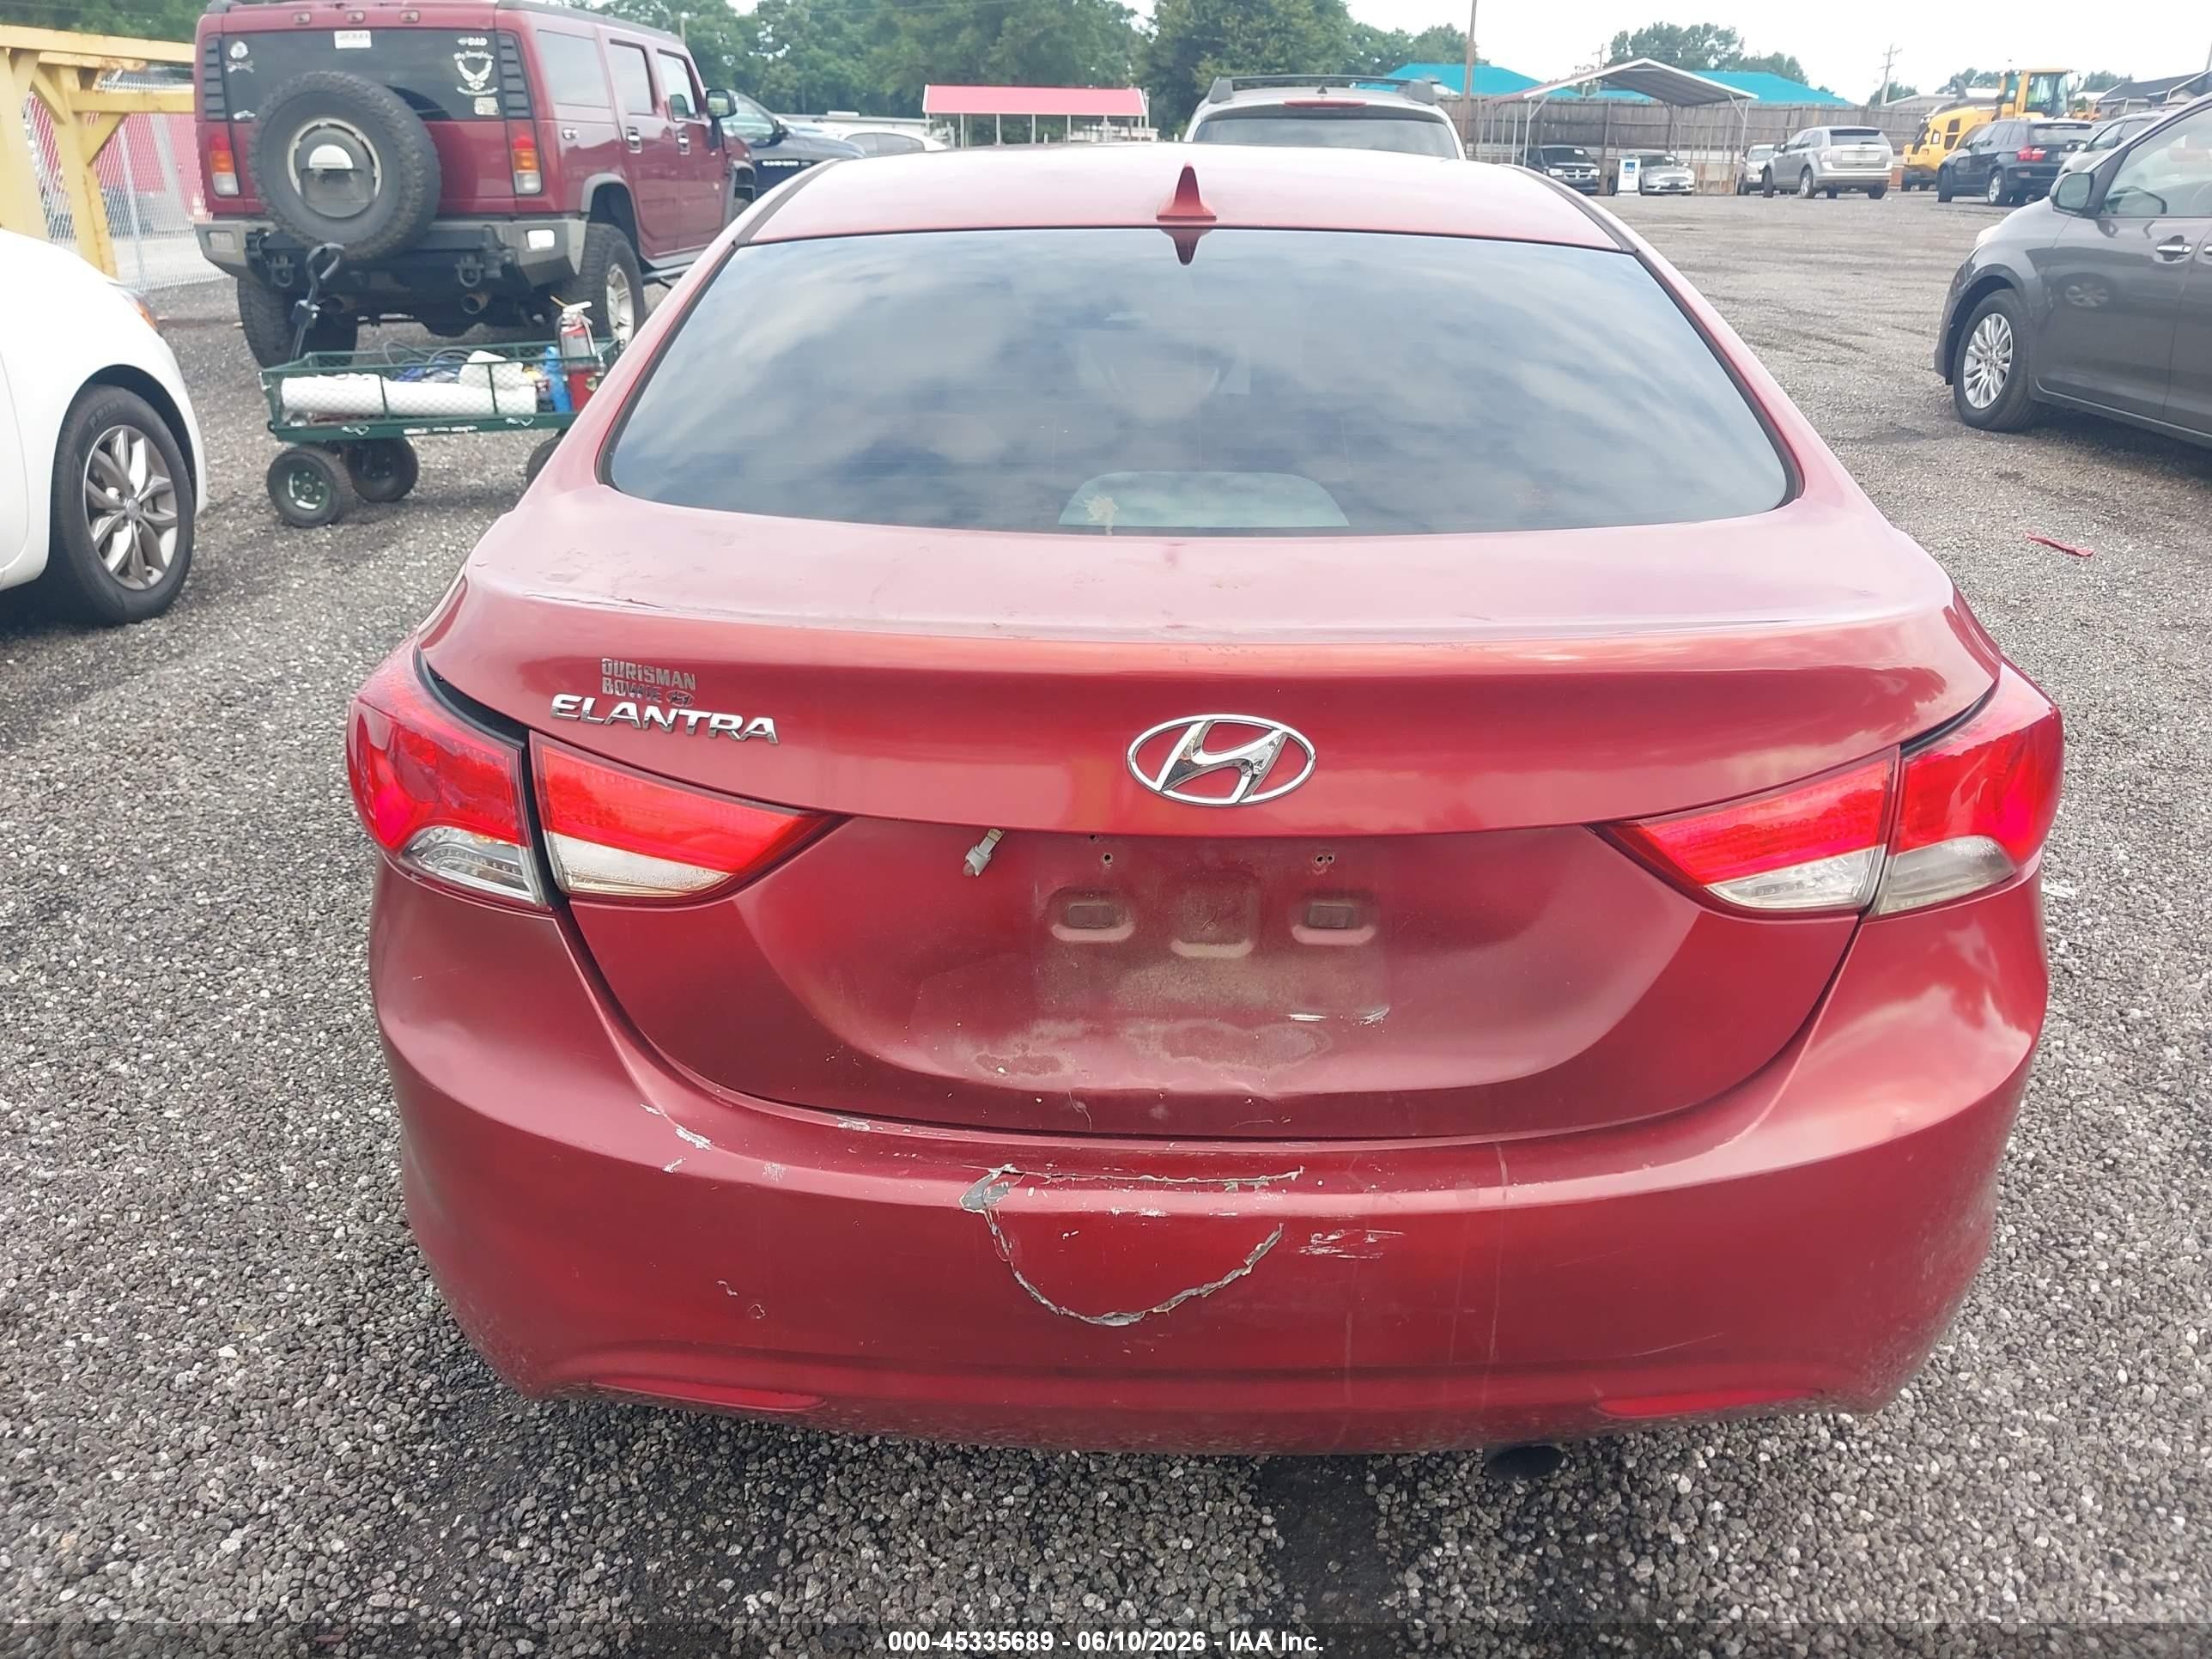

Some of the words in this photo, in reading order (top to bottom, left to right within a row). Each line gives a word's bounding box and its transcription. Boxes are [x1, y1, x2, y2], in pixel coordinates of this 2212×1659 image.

[602, 658, 696, 690] OURISMAN
[602, 677, 662, 704] BOWIE
[550, 693, 779, 744] ELANTRA
